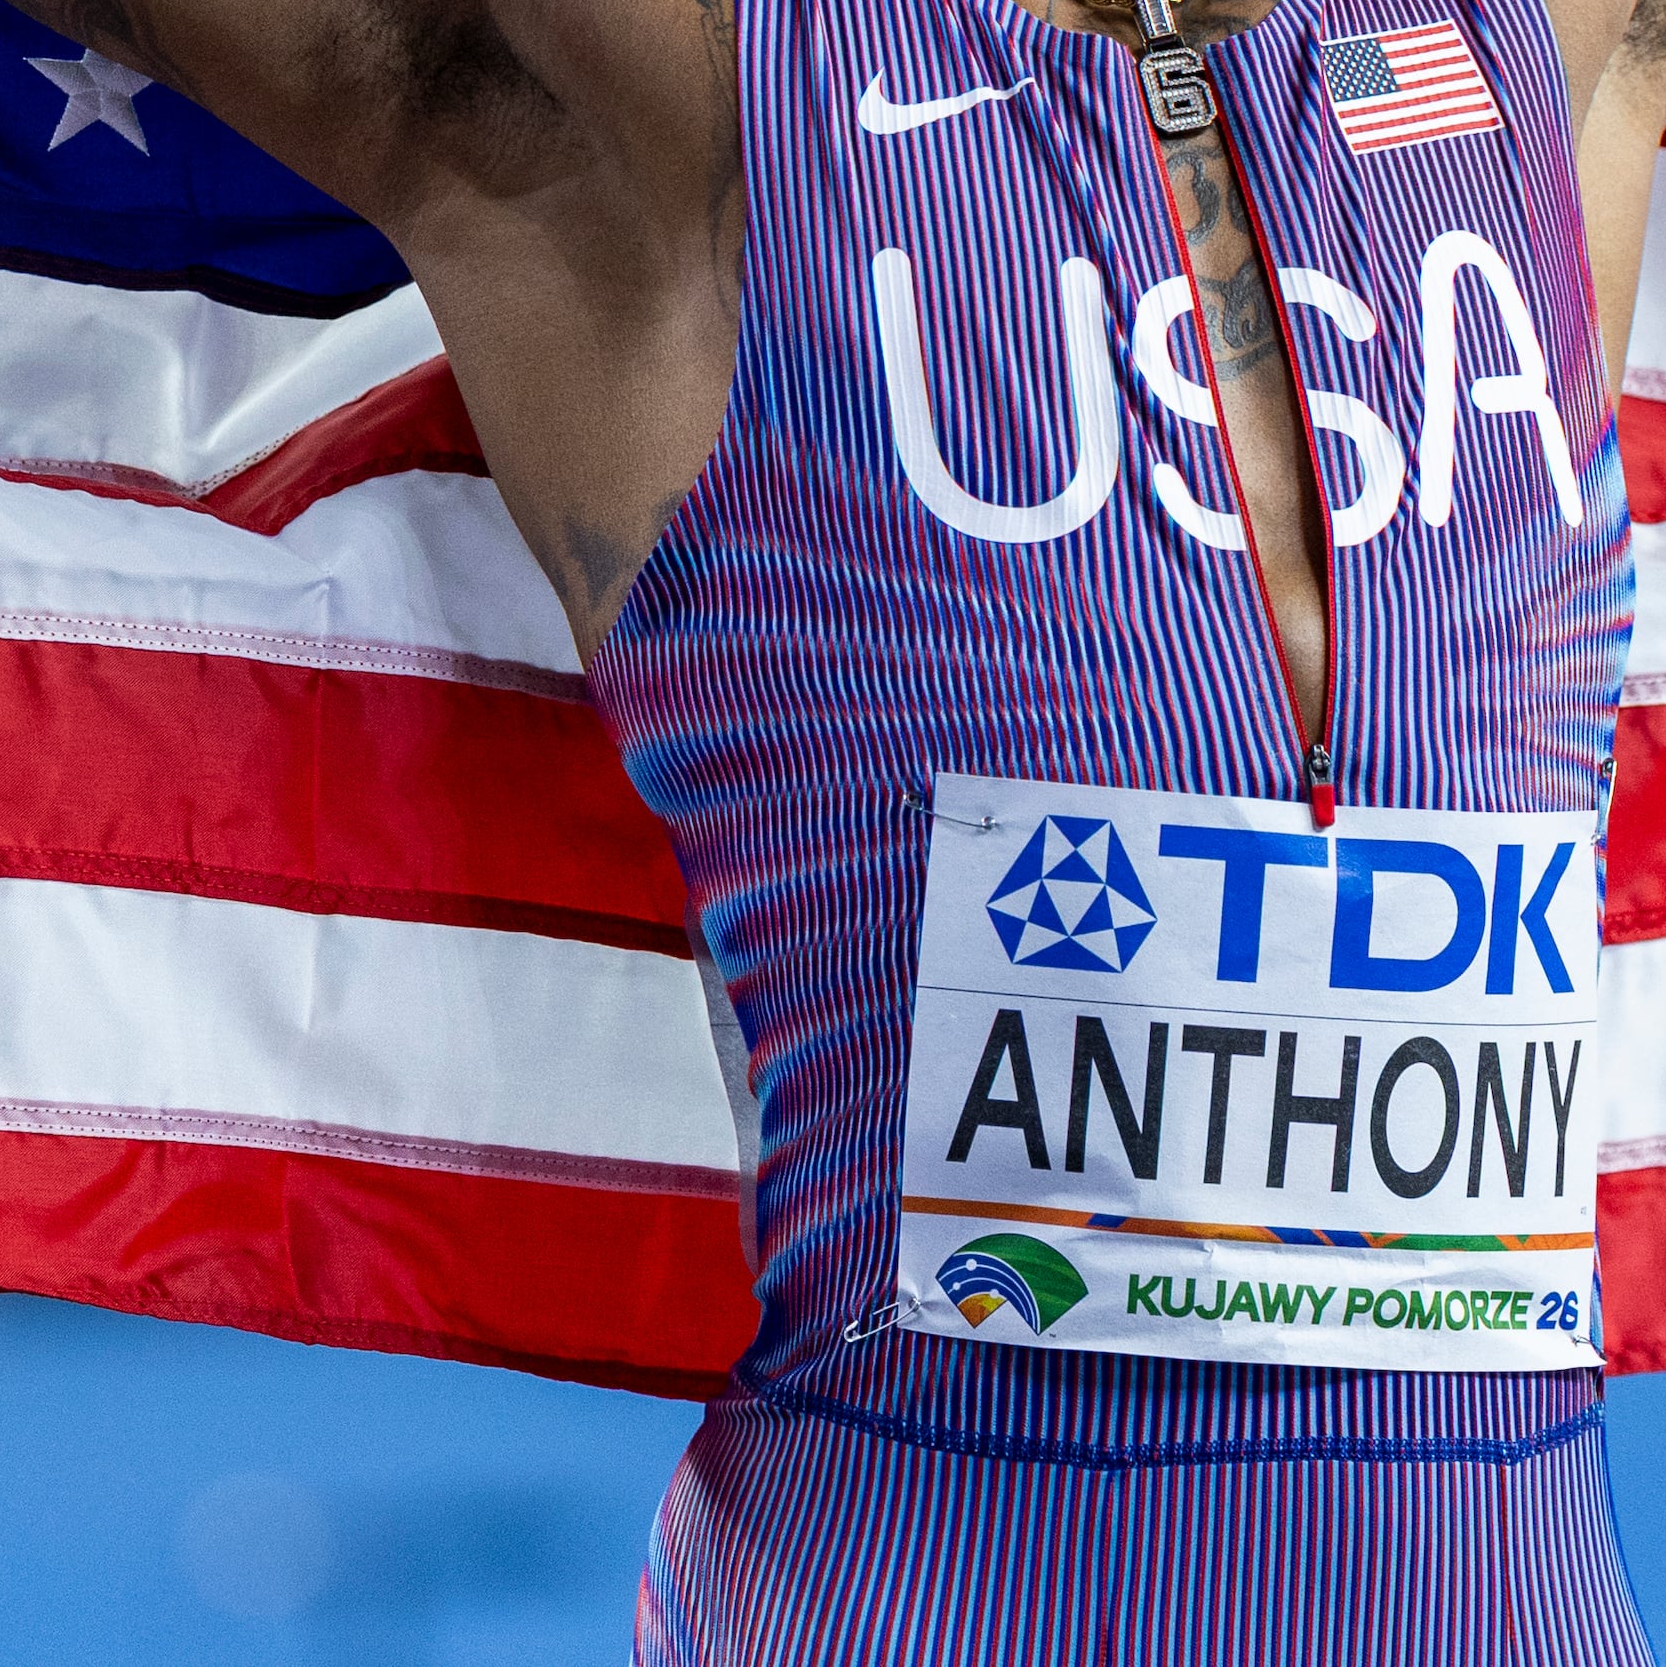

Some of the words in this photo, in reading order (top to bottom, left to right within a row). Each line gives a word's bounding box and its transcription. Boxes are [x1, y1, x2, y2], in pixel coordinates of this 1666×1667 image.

[1139, 46, 1218, 134] 6
[873, 229, 1585, 551] USA
[1158, 823, 1576, 995] TDK
[945, 1008, 1583, 1199] ANTHONY
[1126, 1274, 1337, 1325] KUJAWY
[1343, 1287, 1534, 1331] POMORZE
[1536, 1290, 1579, 1331] 26
